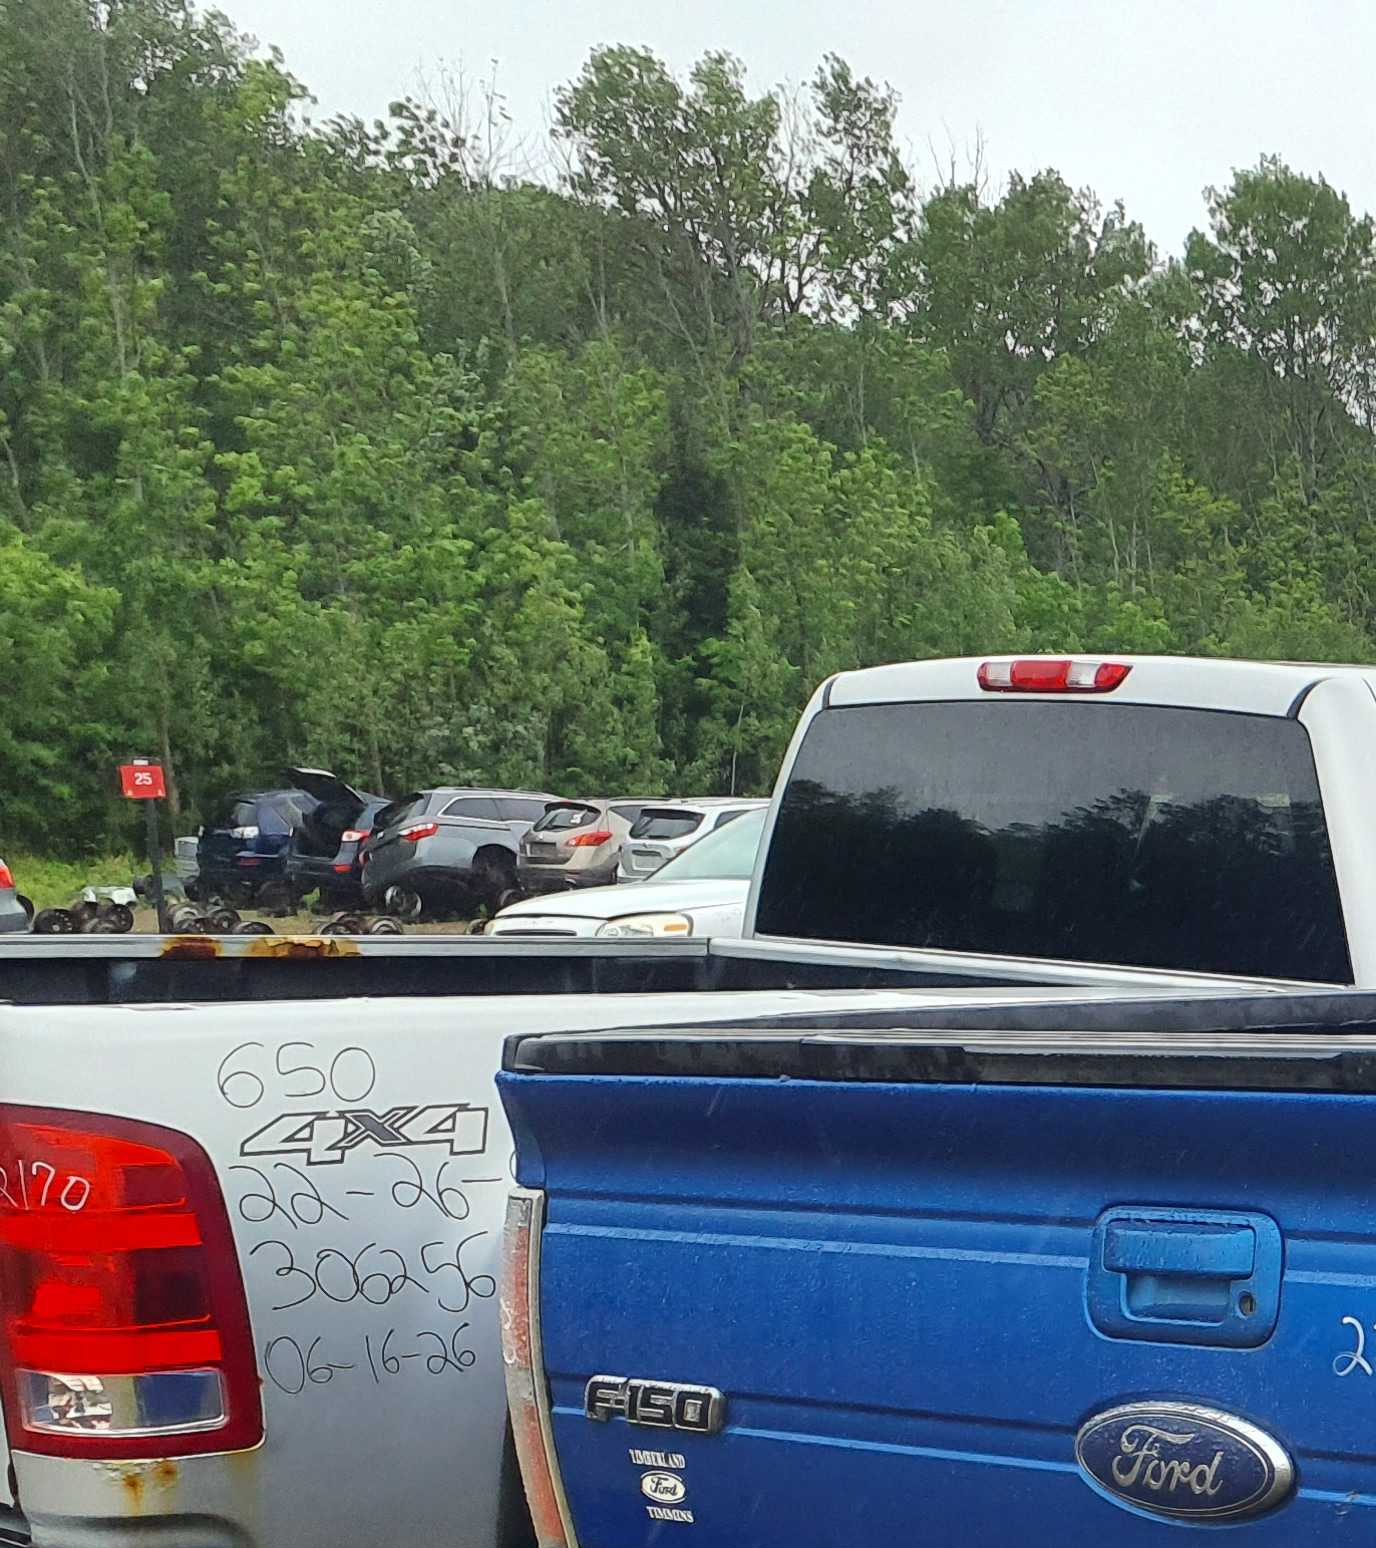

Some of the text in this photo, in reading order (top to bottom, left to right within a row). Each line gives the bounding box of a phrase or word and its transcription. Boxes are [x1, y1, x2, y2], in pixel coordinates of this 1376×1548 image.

[134, 772, 153, 785] 25
[217, 1043, 376, 1108] 650
[229, 1152, 518, 1230] 22-26-
[264, 1323, 476, 1394] 06-16-26
[649, 1476, 679, 1497] Ford
[1110, 1423, 1222, 1497] Ford
